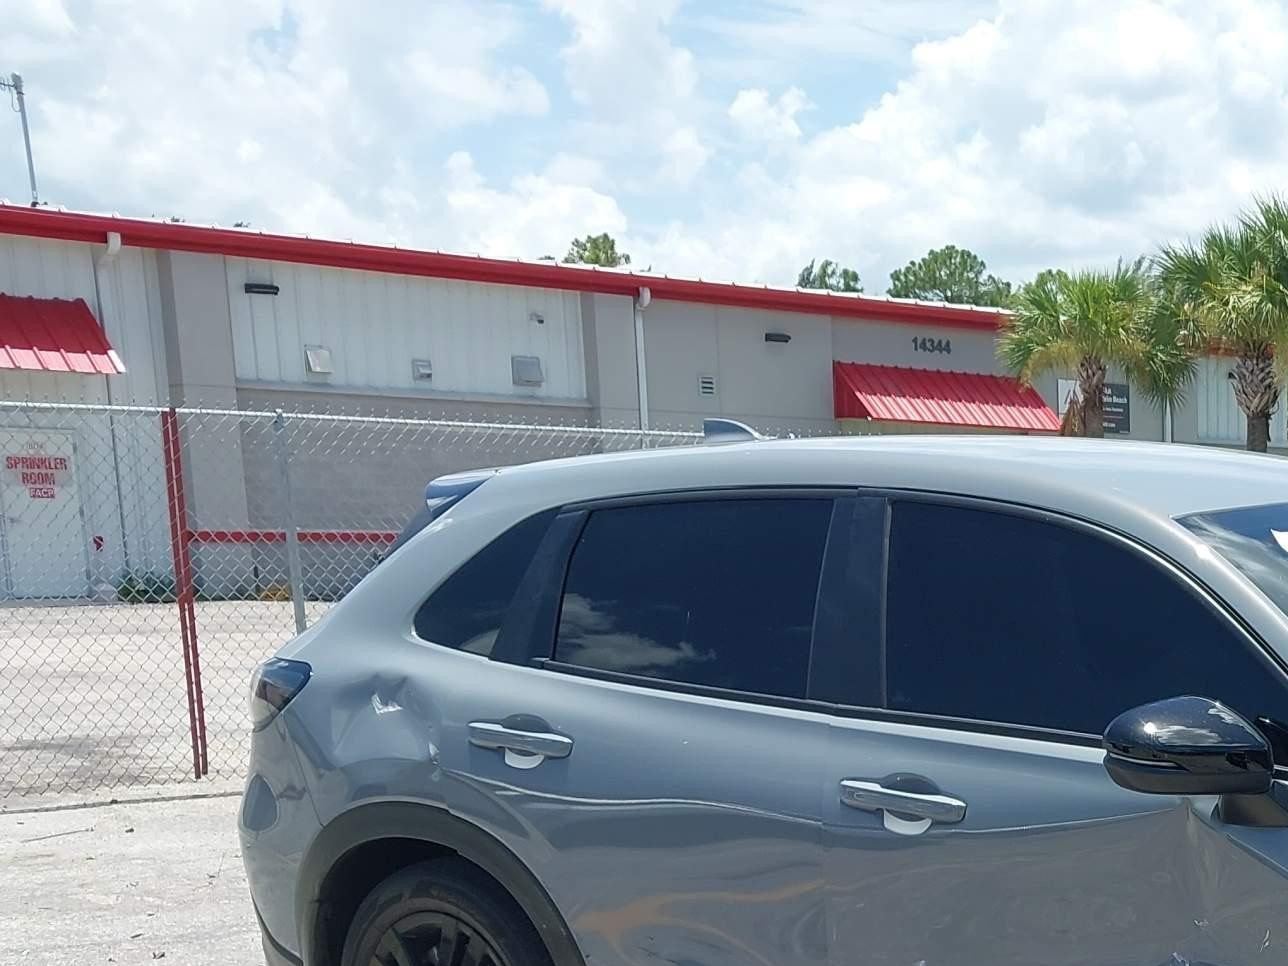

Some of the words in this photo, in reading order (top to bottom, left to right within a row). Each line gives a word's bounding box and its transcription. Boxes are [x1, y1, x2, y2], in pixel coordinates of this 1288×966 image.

[911, 336, 952, 354] 14344
[6, 456, 68, 470] SPRINKLER
[22, 472, 55, 485] ROOM
[31, 488, 54, 497] FACP
